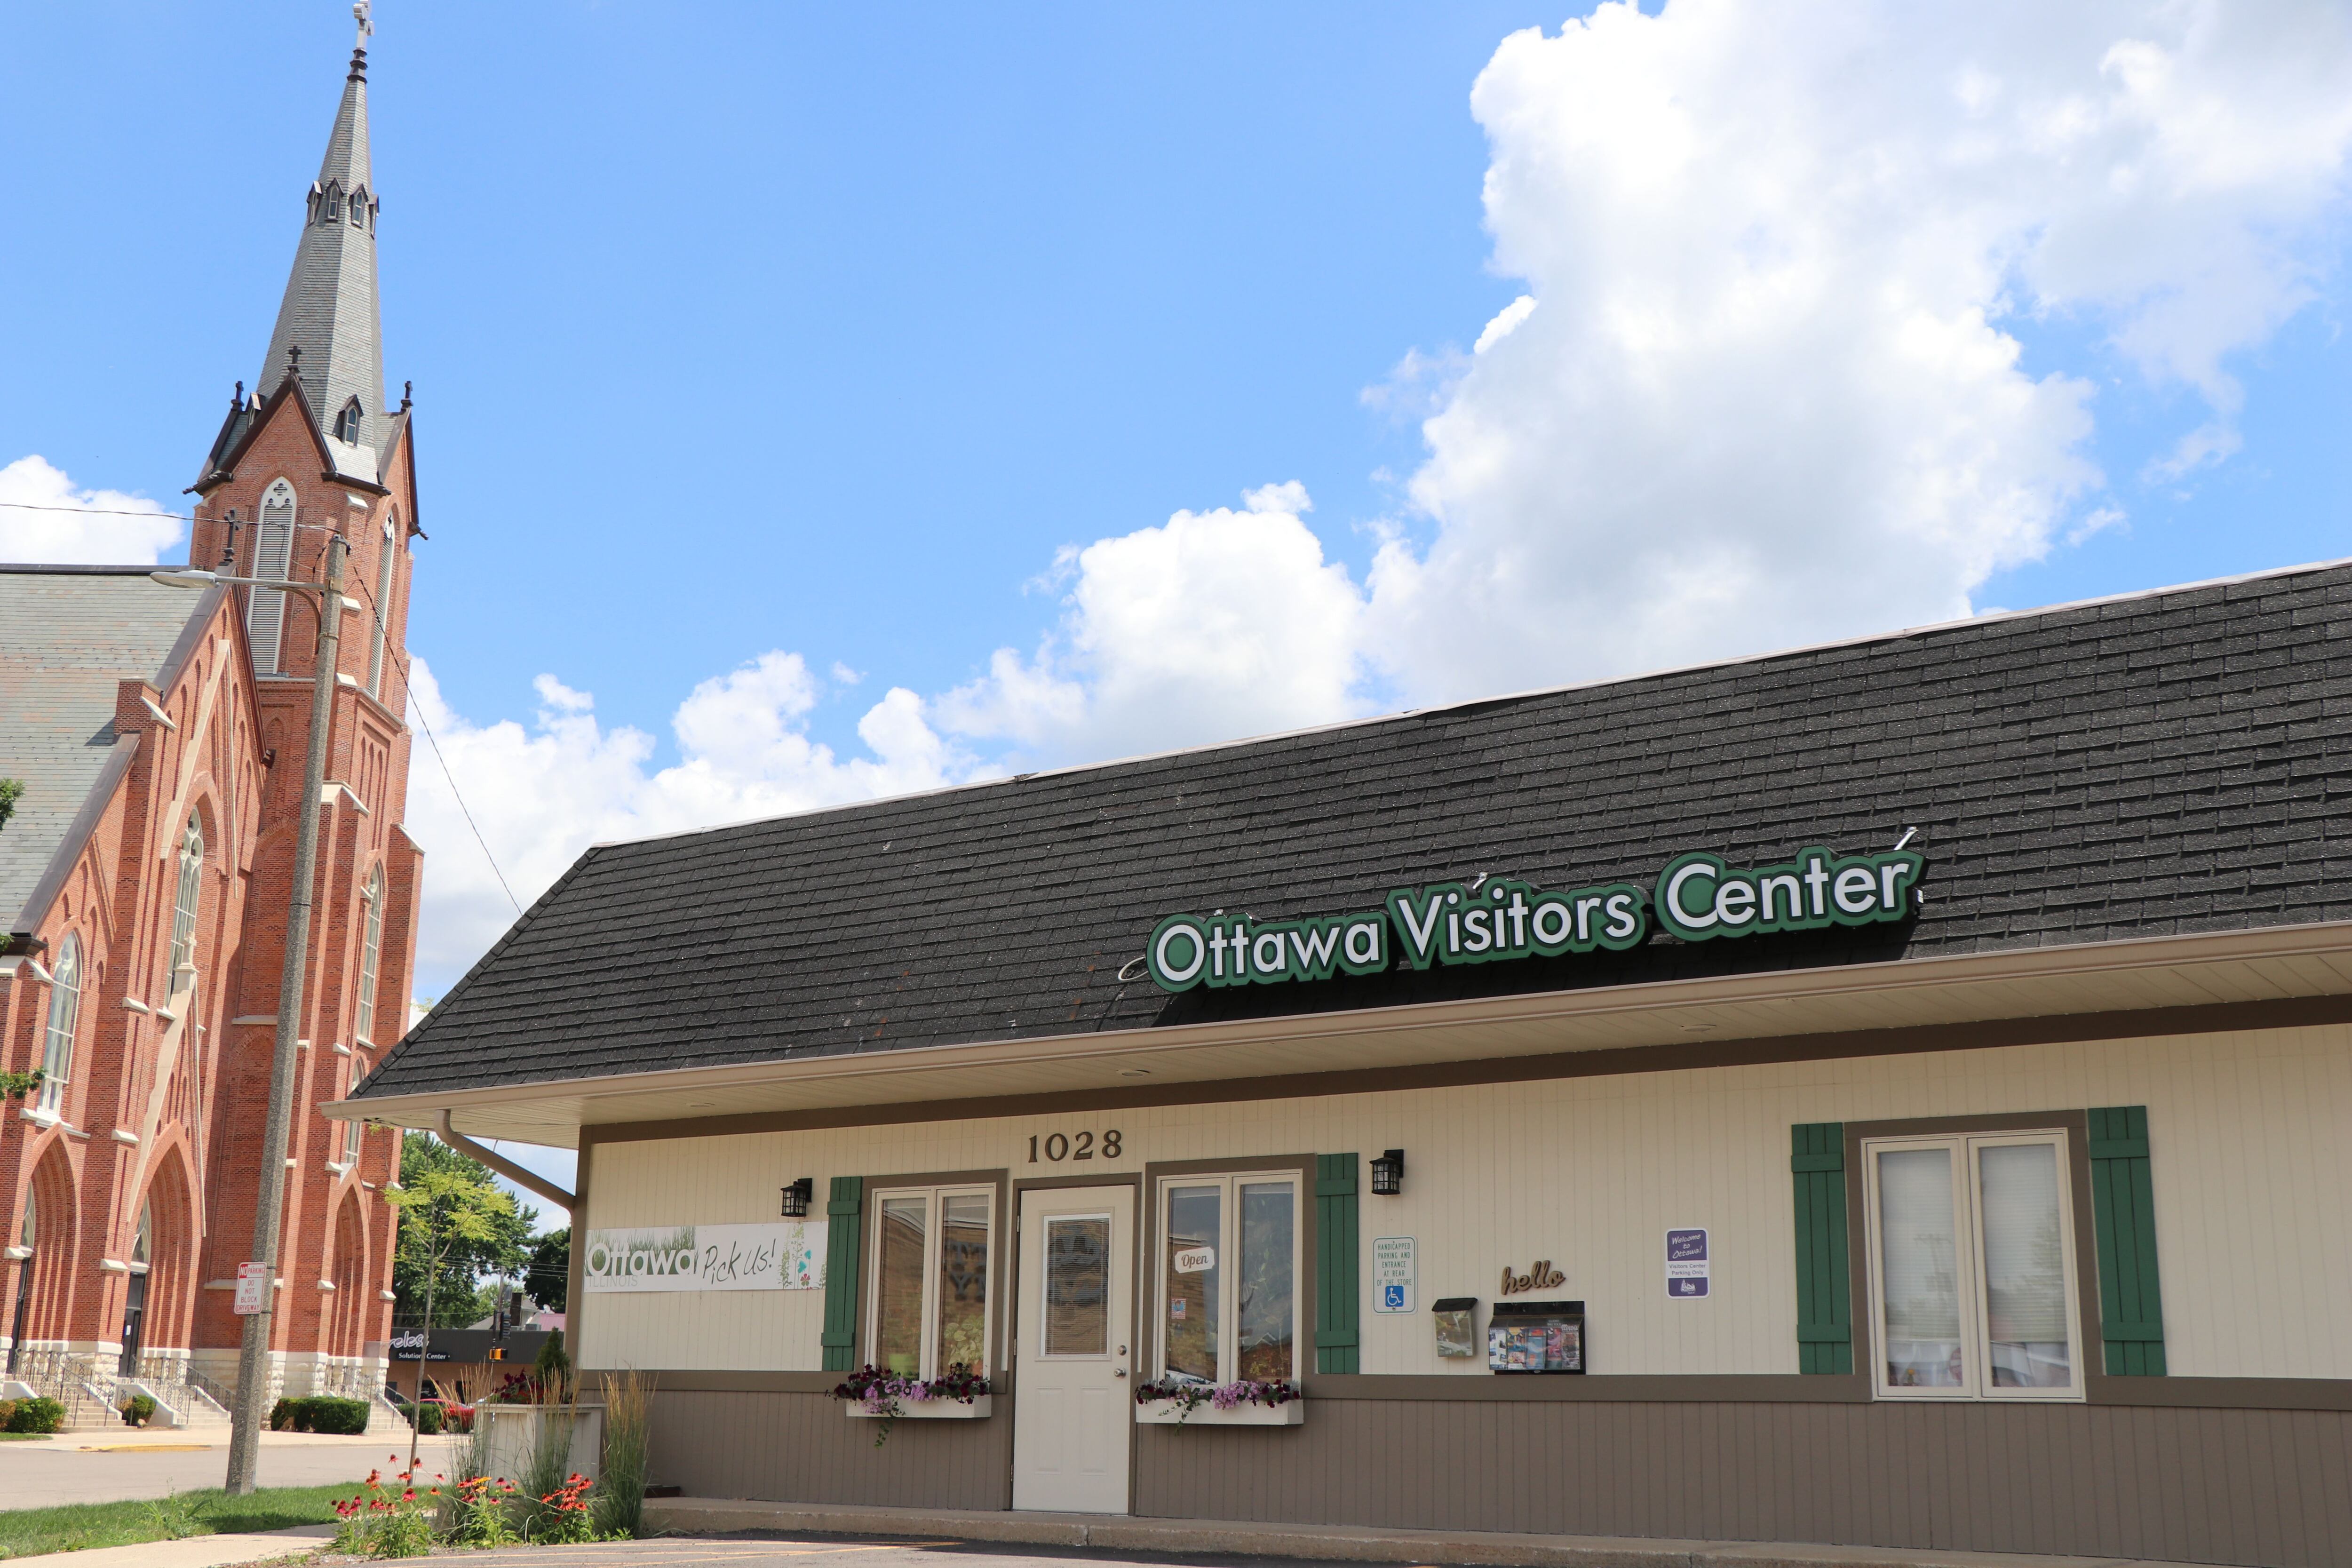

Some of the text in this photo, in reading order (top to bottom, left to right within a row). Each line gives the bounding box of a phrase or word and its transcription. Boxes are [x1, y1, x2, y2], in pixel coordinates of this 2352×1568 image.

[1156, 858, 1909, 981] Ottawa Visitors Center
[1028, 1130, 1122, 1163] 1028
[1672, 1234, 1701, 1245] Welcome
[1672, 1245, 1702, 1259] Ottawa!
[588, 1239, 776, 1284] Ottawa Pick Us!
[1181, 1254, 1209, 1269] Open
[240, 1266, 247, 1276] NO
[1501, 1260, 1566, 1295] hello
[589, 1275, 638, 1288] ILLINOIS
